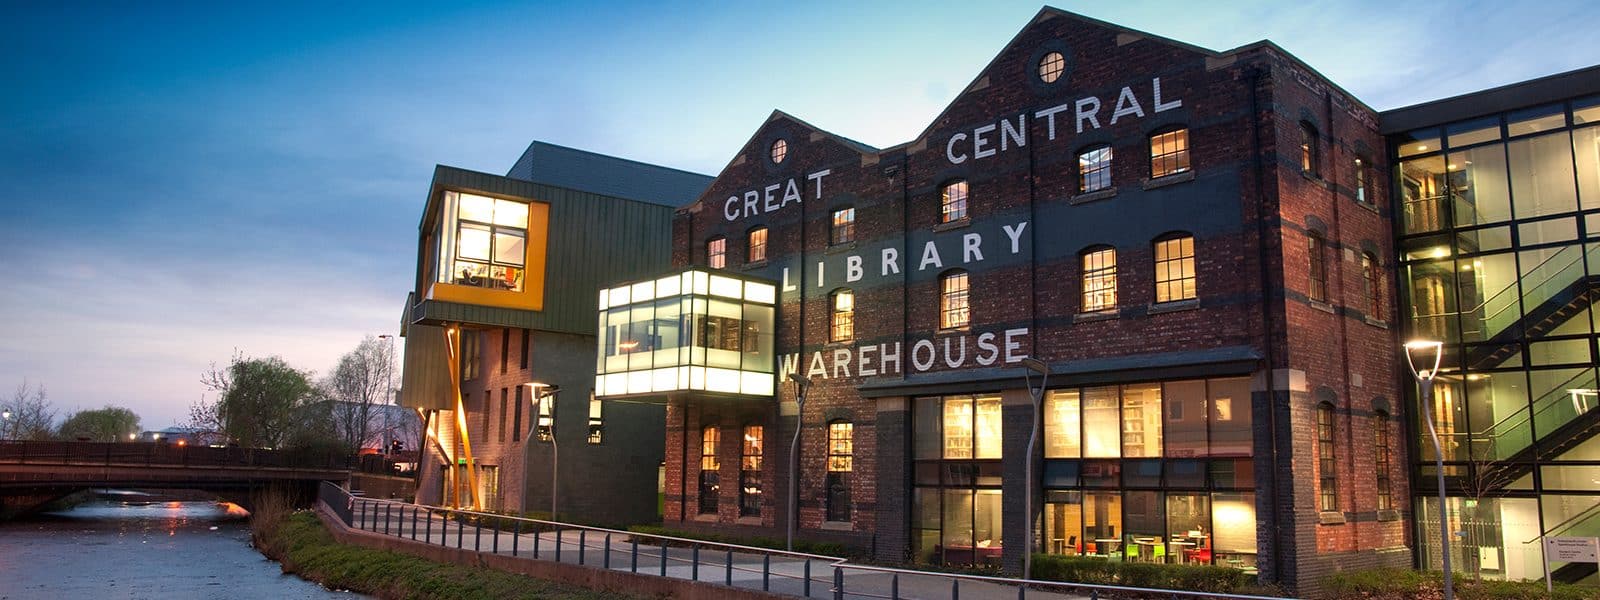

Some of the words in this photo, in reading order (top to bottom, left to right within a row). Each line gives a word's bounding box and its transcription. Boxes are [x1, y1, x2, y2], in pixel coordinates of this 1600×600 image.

[724, 170, 830, 221] GREAT
[948, 78, 1183, 164] CENTRAL
[783, 222, 1028, 292] LIBRARY
[778, 328, 1028, 382] WAREHOUSE
